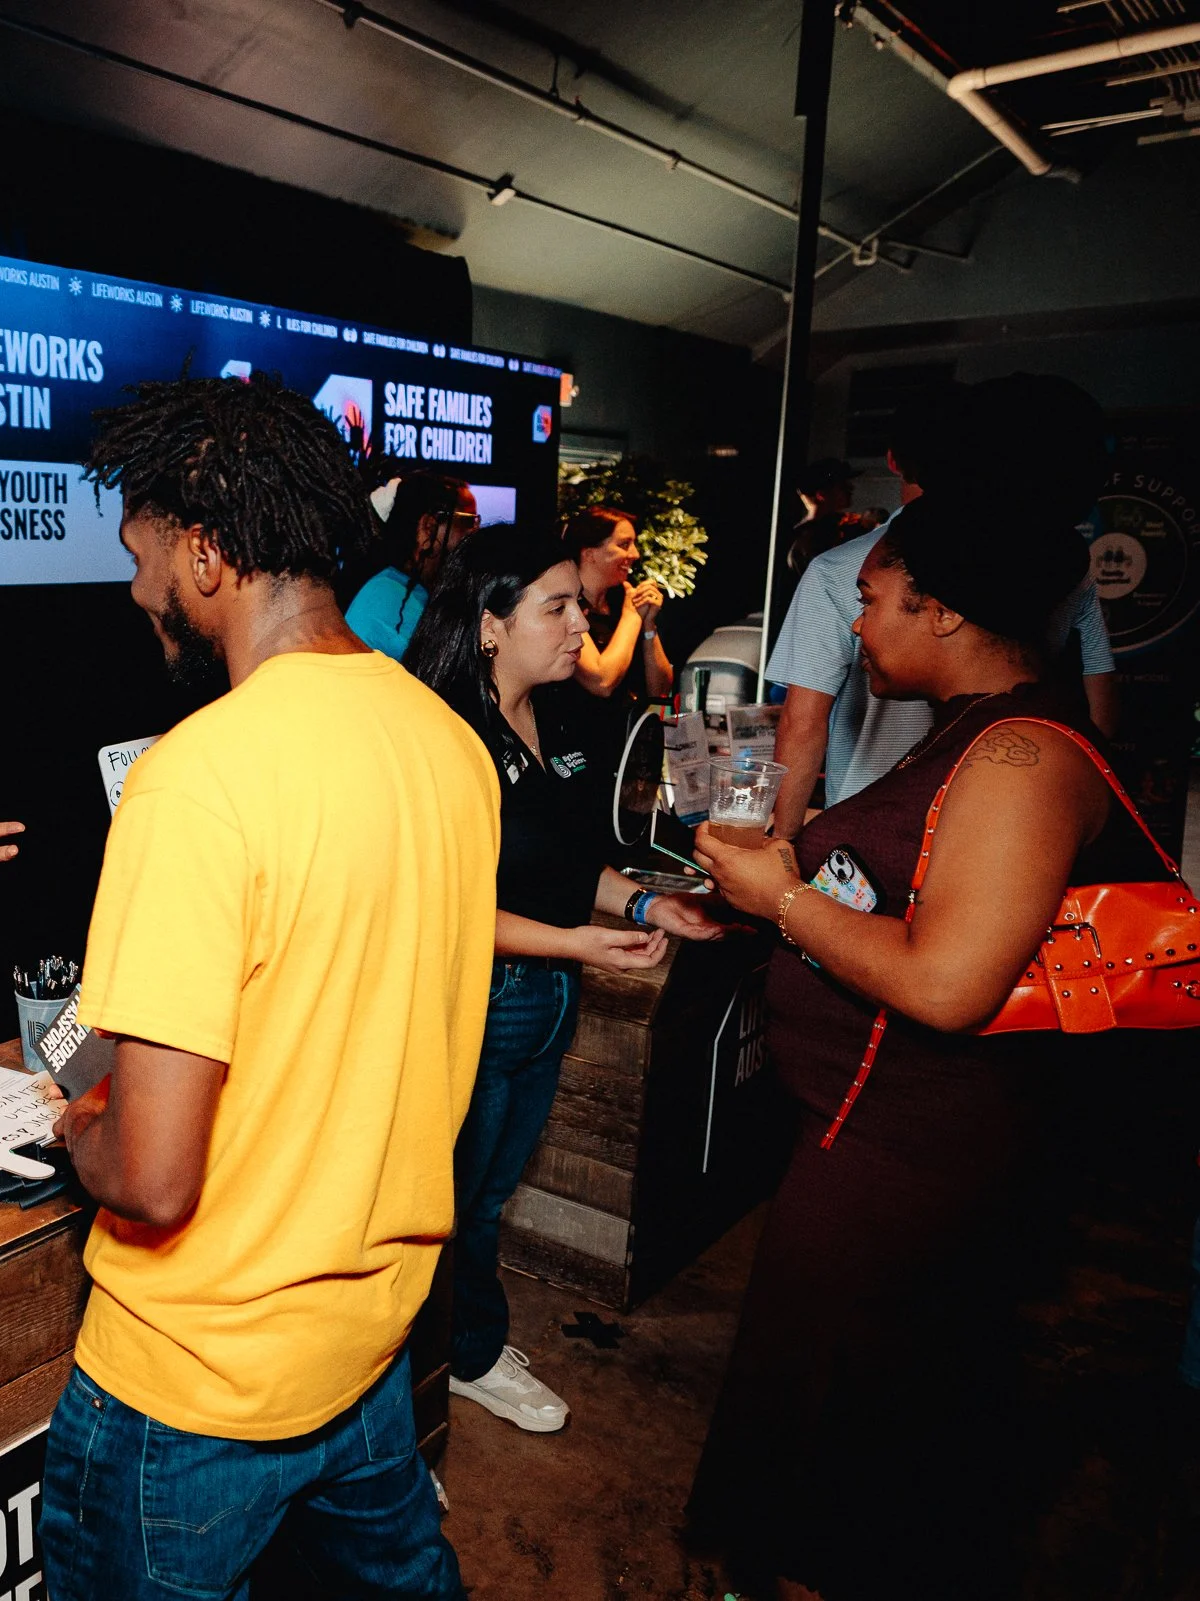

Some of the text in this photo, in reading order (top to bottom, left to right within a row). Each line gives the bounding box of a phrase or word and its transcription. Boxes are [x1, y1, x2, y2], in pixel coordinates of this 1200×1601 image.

[29, 273, 60, 291] AUSTIN
[92, 282, 163, 308] LIFEWORKS AUSTIN
[191, 300, 253, 324] LIFEWORKS AUSTIN
[384, 381, 492, 428] SAFE FAMILIES
[384, 422, 492, 465] FOR CHILDREN
[47, 1023, 87, 1074] PLEDGE
